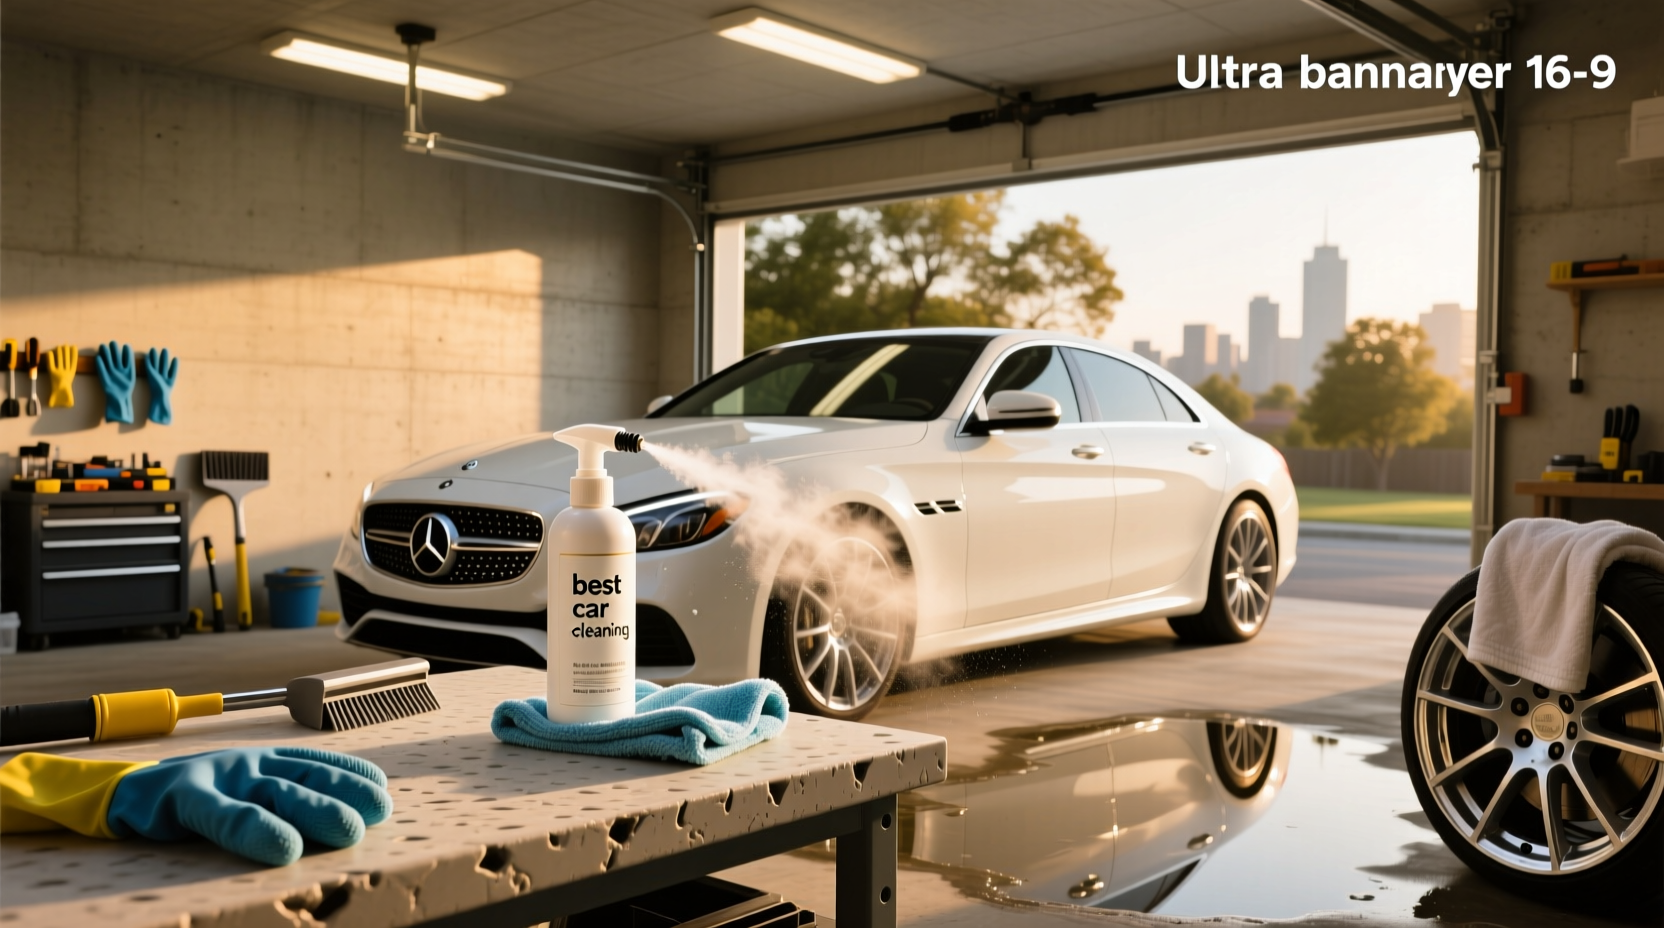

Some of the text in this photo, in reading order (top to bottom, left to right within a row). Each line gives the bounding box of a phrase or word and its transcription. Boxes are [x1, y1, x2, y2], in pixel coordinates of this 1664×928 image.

[572, 573, 622, 595] best
[572, 602, 609, 618] car
[571, 622, 630, 640] cleaning
